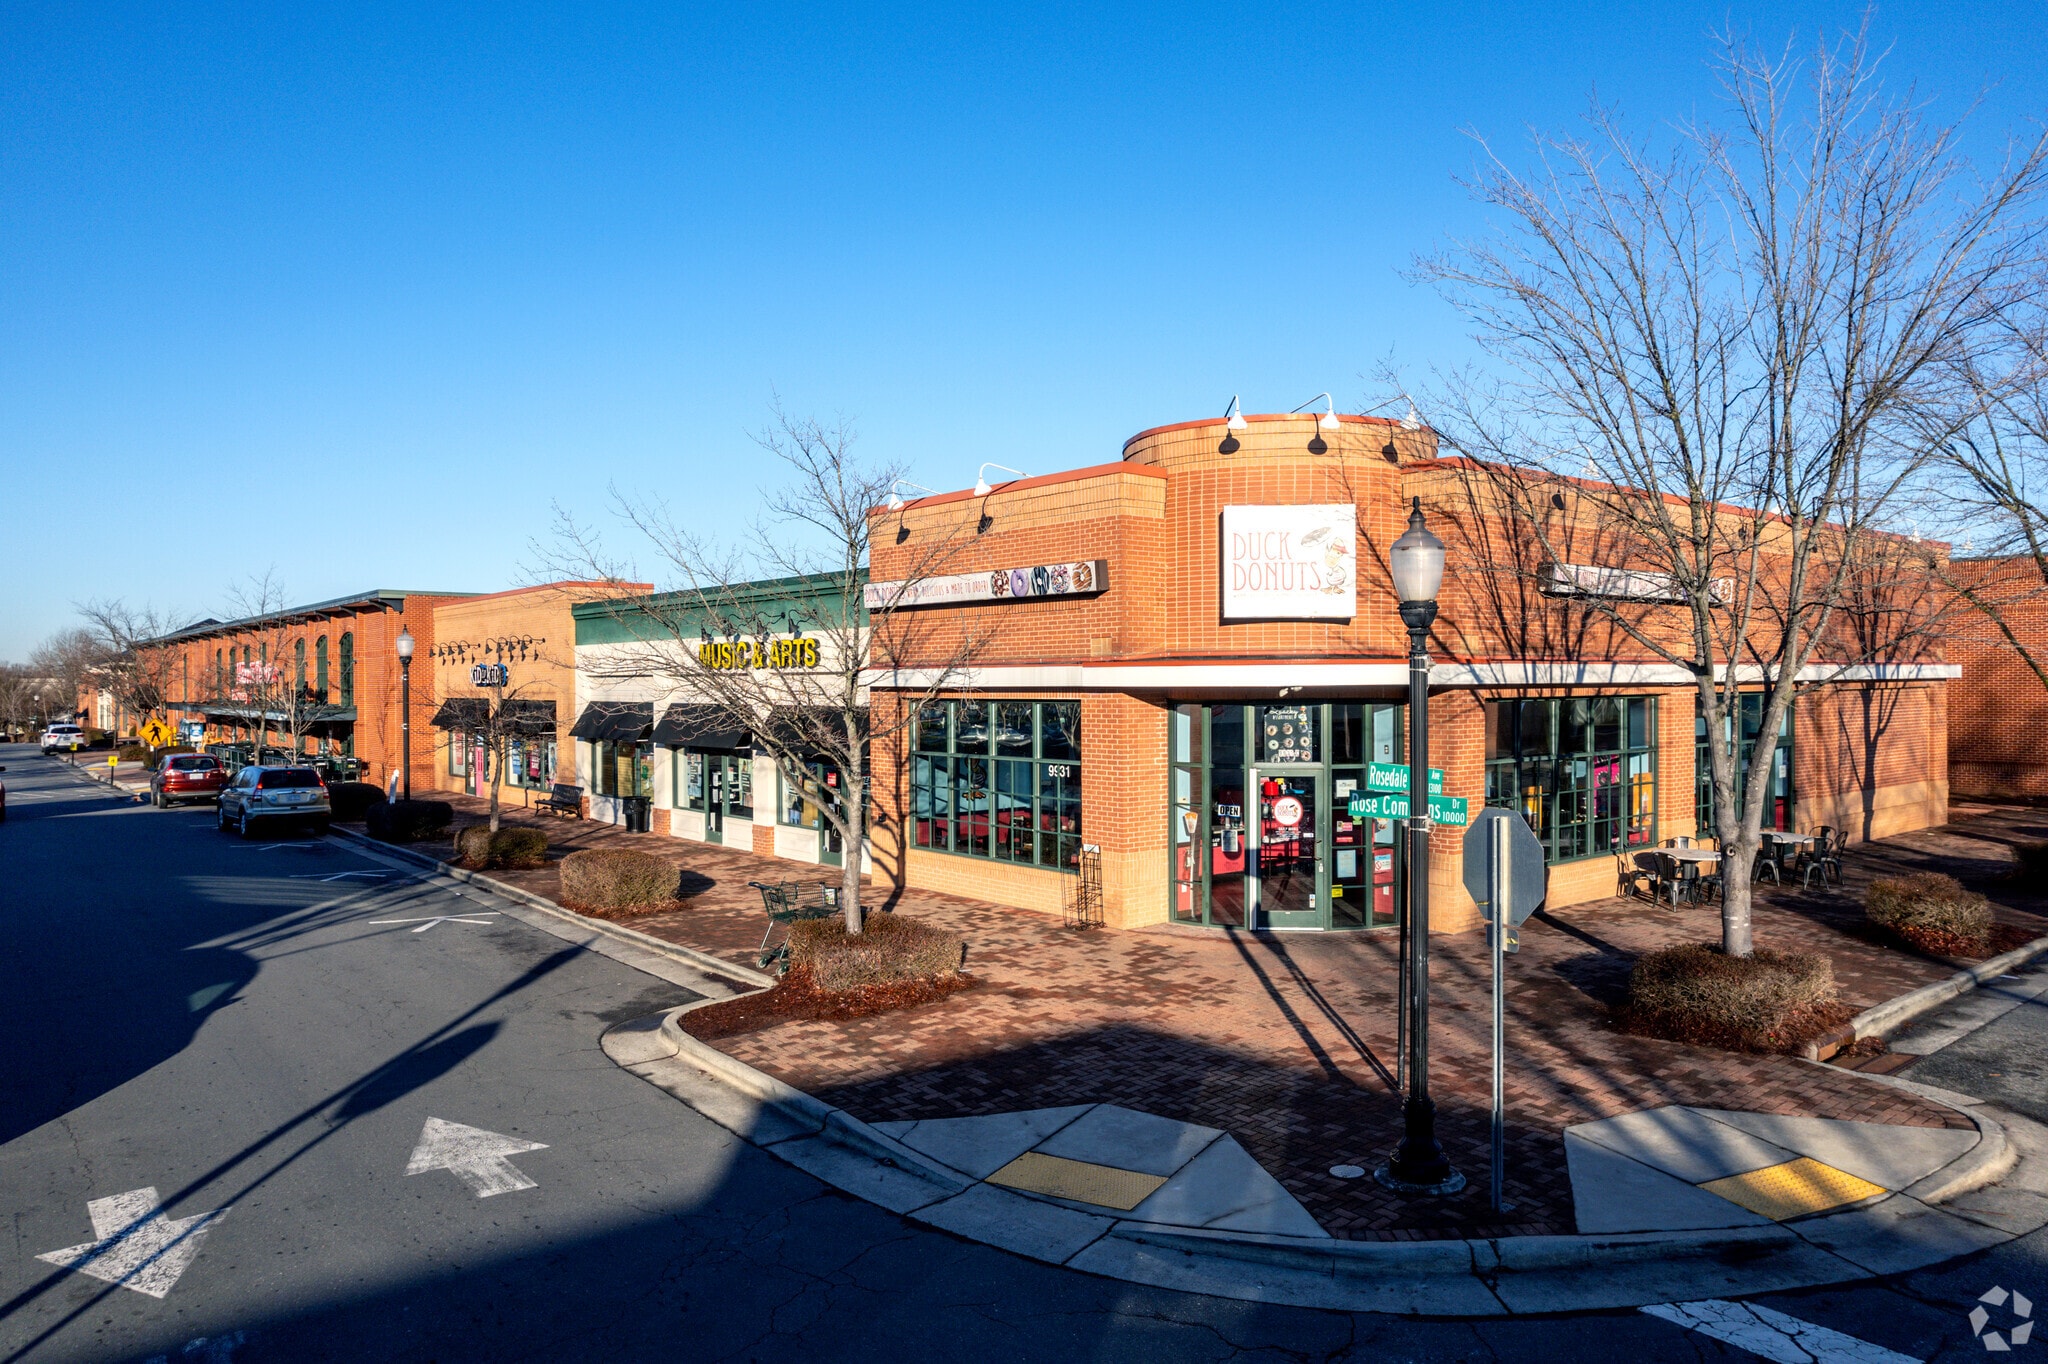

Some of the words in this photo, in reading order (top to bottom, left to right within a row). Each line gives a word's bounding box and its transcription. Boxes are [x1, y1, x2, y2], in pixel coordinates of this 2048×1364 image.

[1233, 531, 1292, 560] DUCK
[1233, 561, 1321, 591] DONUTS
[699, 641, 748, 669] MUSIC
[752, 641, 763, 669] &
[769, 638, 816, 667] ARTS
[1048, 764, 1070, 778] 9931
[1369, 765, 1408, 788] Rosedale
[1431, 770, 1440, 781] Ave
[1219, 805, 1239, 815] OPEN
[1351, 792, 1378, 814] Rose
[1382, 795, 1441, 819] Comns
[1452, 799, 1461, 809] Dr
[1442, 811, 1465, 823] 10000
